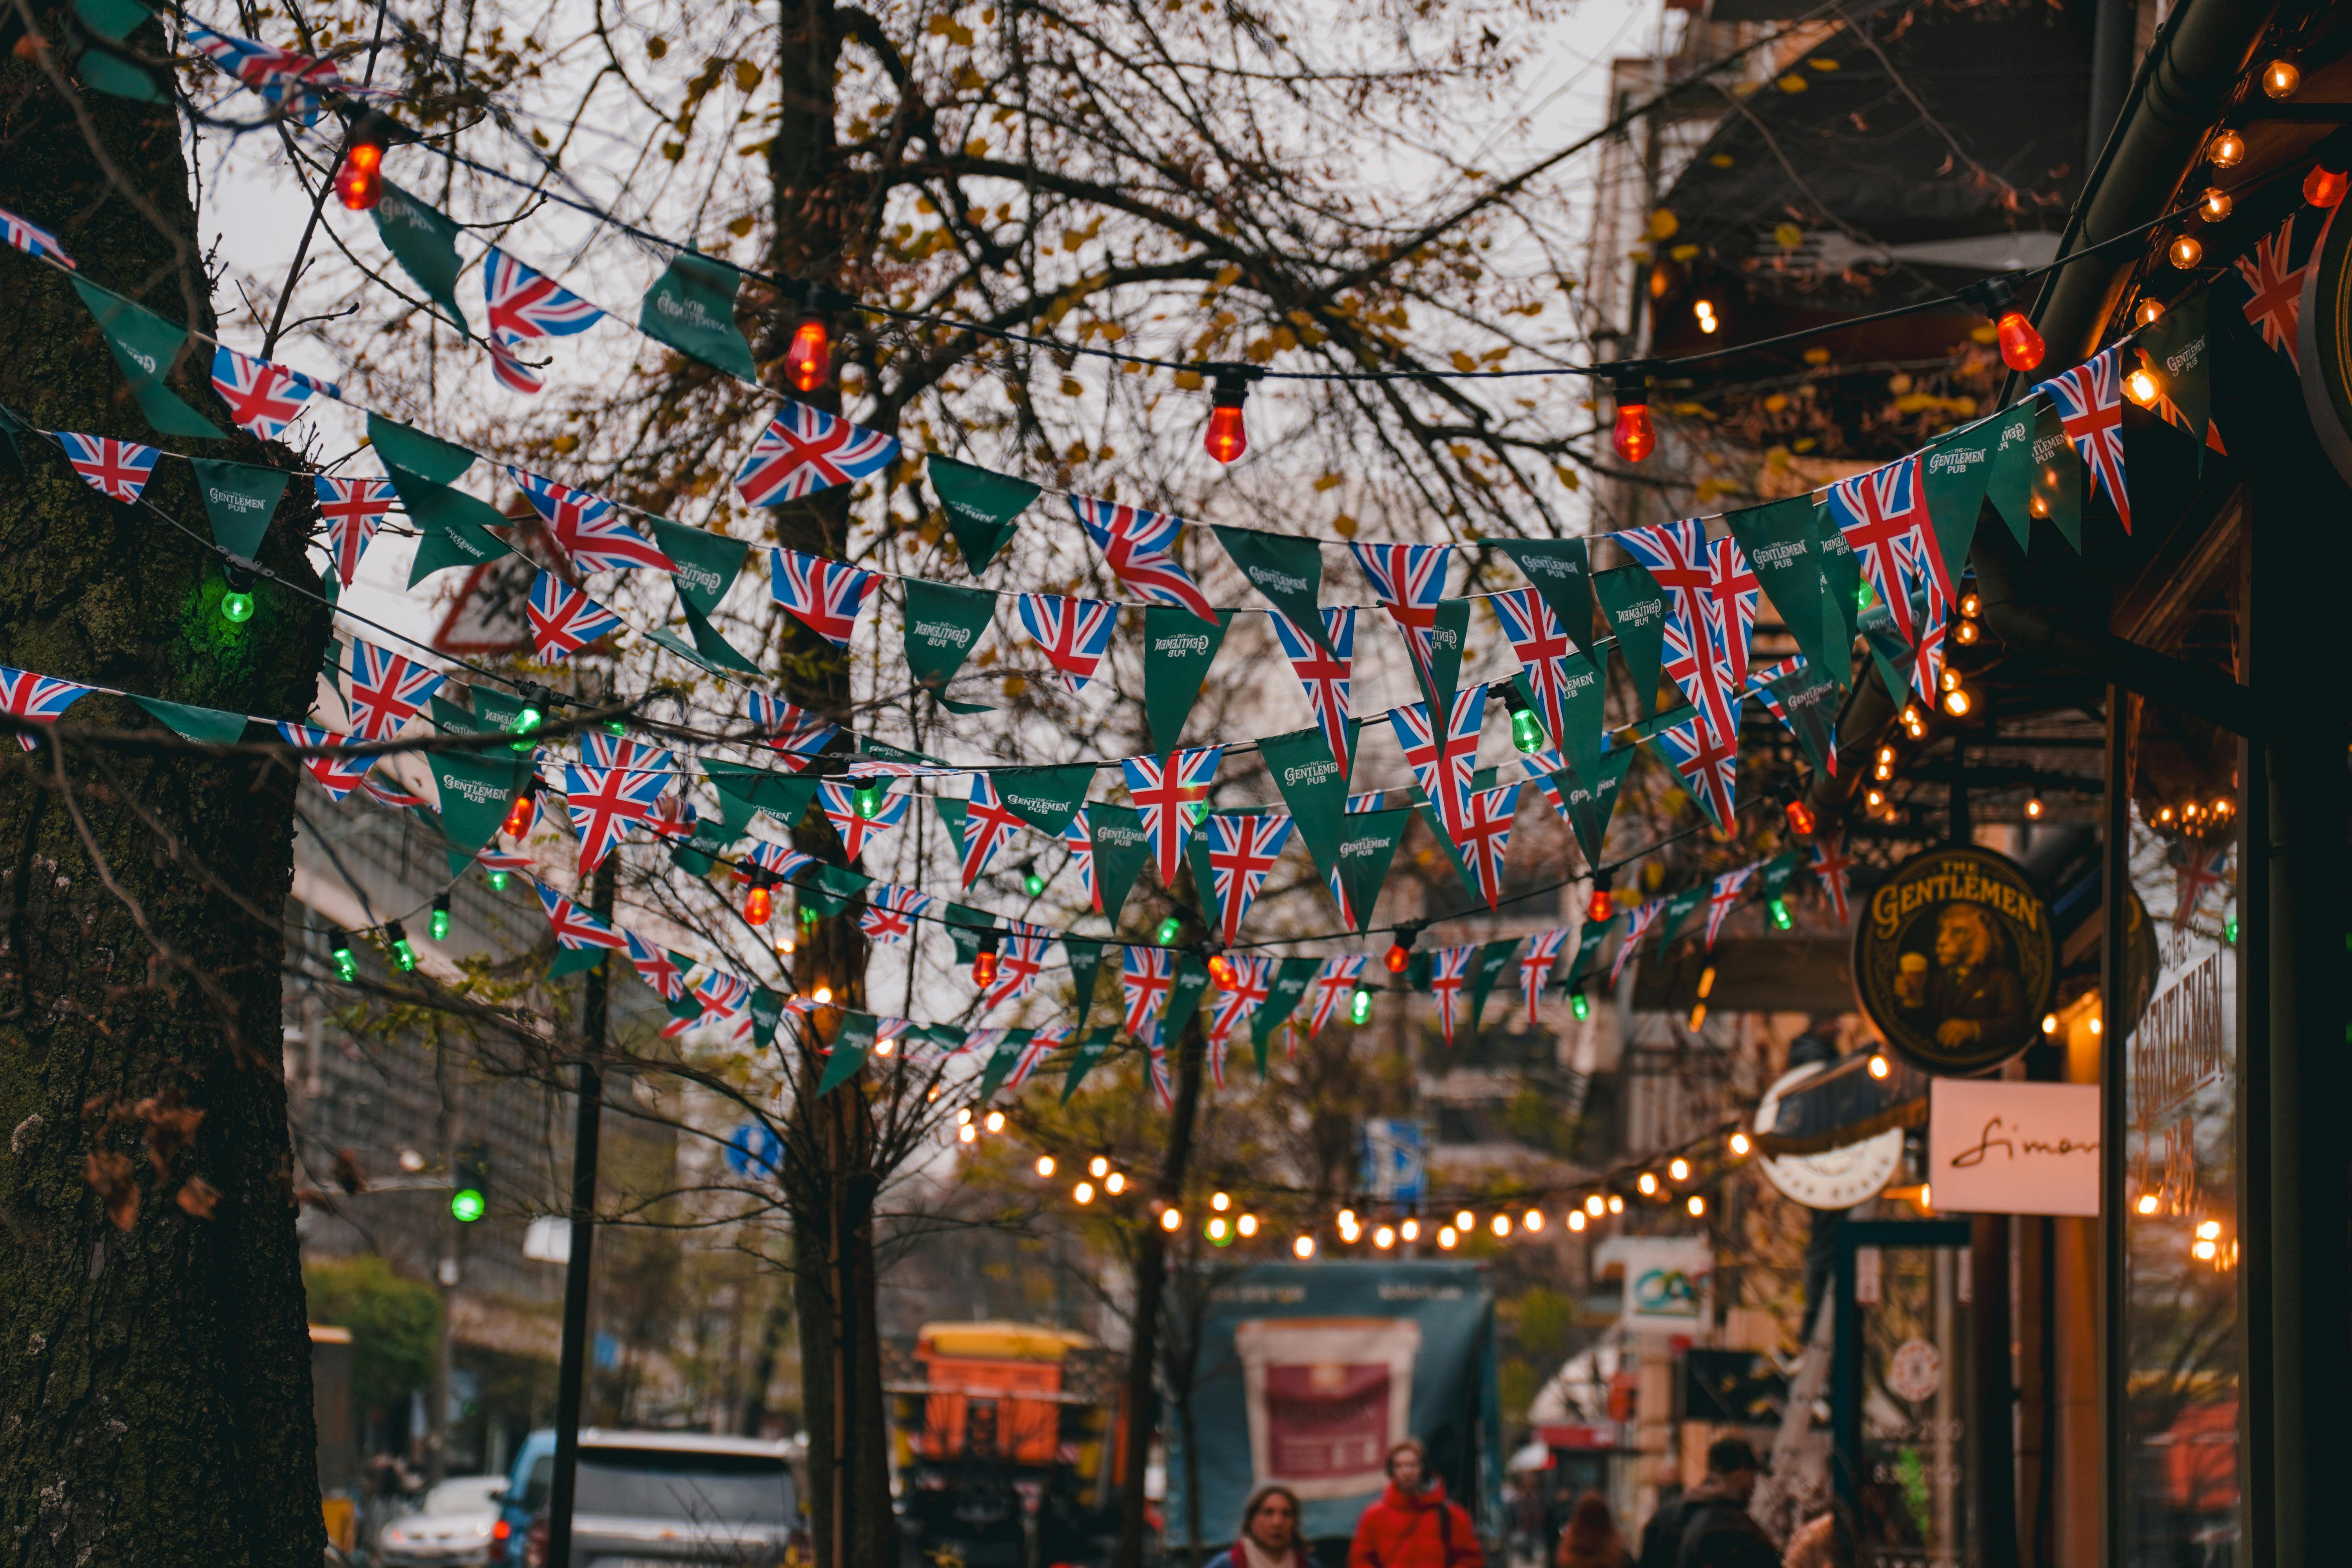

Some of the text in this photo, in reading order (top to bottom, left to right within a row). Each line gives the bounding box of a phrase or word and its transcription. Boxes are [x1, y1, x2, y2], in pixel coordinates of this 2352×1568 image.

[2167, 334, 2205, 377] GENTLEMEN
[2186, 357, 2198, 372] PUB
[2032, 430, 2067, 457] TLEMEN
[1929, 448, 1987, 474] GENTLEMEN
[2035, 450, 2055, 464] PUB
[1947, 464, 1967, 474] PUB
[210, 488, 265, 510] GENTLEMEN
[228, 505, 247, 513] PUB
[1753, 539, 1809, 570] GENTLEMEN
[1521, 555, 1579, 575] GENTLEMEN
[1773, 558, 1793, 570] PUB
[1249, 565, 1308, 592] GENTLEMEN
[1546, 568, 1566, 579] PUB
[1273, 582, 1294, 595] PUB
[1565, 671, 1595, 690] LEMEN
[1564, 690, 1578, 699] UB
[1788, 679, 1833, 711] GENTLEMEN
[443, 775, 510, 801] GENTLEMEN
[1307, 775, 1327, 786] PUB
[463, 792, 485, 804] PUB
[1007, 794, 1071, 812] GENTLEMEN
[1098, 827, 1148, 843] GENTLEMEN
[1113, 838, 1132, 847] PUB
[1340, 837, 1390, 858] GENTLEMEN
[1357, 849, 1374, 857] PUB
[1942, 861, 1976, 875] THE
[1871, 874, 2044, 940] GENTLEMEN
